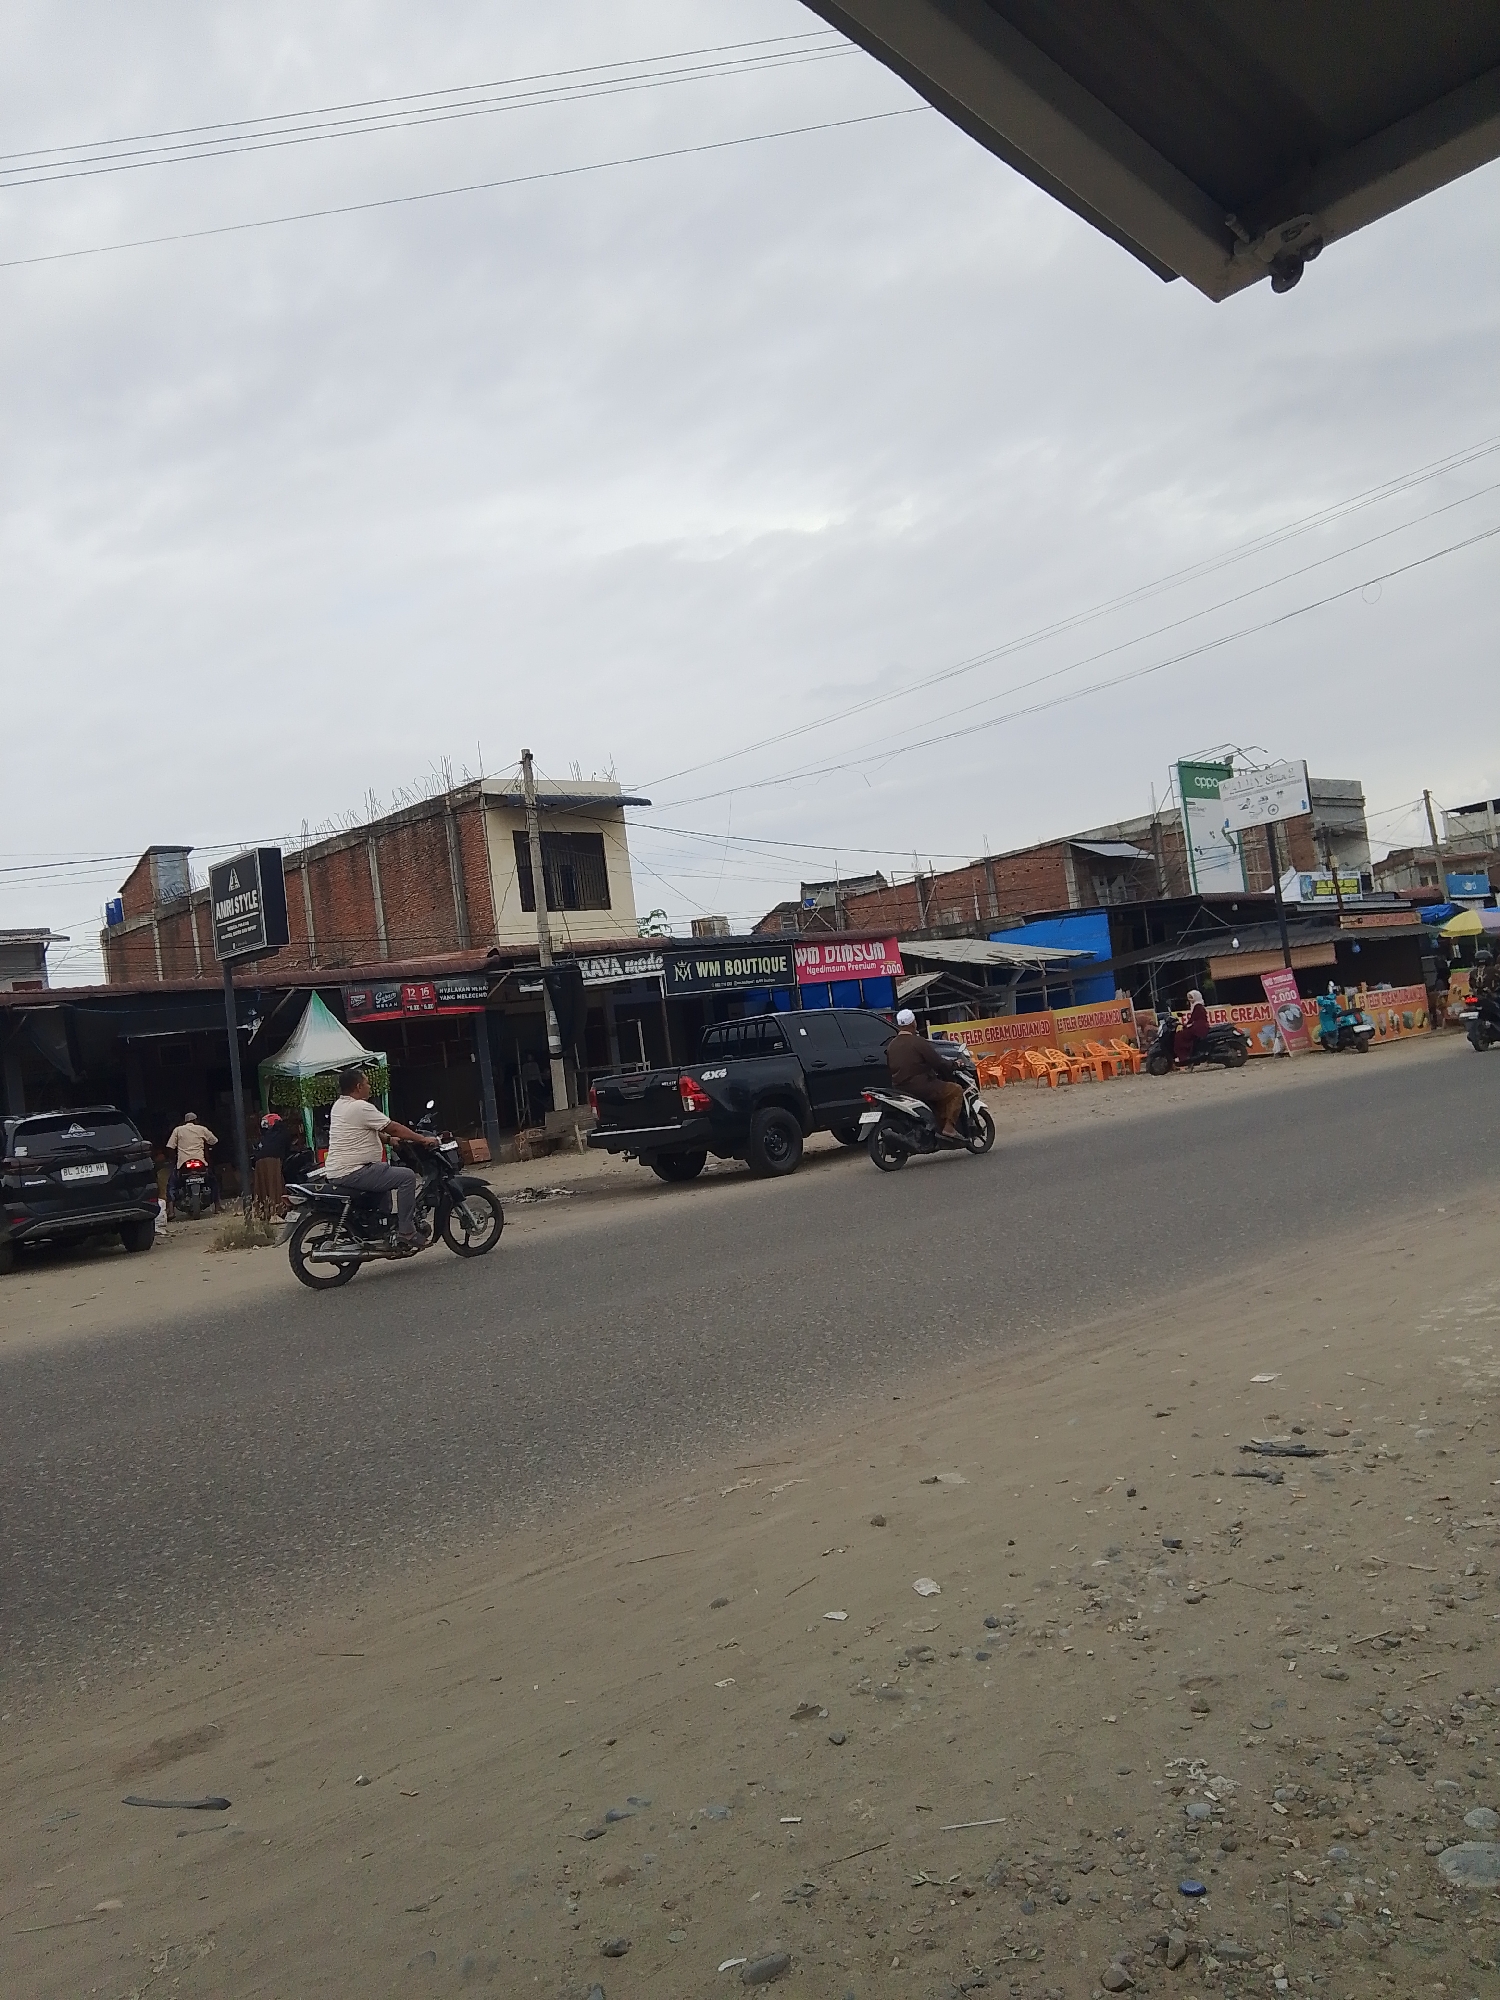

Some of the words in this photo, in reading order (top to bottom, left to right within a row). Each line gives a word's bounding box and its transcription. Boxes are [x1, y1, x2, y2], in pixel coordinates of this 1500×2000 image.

[1195, 776, 1219, 789] oppo
[235, 889, 259, 914] STYLE
[795, 946, 820, 967] WM
[824, 942, 885, 964] DIMSUM
[696, 960, 721, 978] WM
[724, 956, 788, 976] BOUTIQUE
[806, 964, 847, 976] Ngedimsum
[847, 961, 877, 972] Premium
[879, 963, 902, 975] 2.000
[406, 987, 416, 998] 12
[1272, 990, 1297, 1003] 2.000
[1230, 1005, 1271, 1022] CREAM
[961, 1029, 984, 1045] TELER
[984, 1024, 1012, 1042] CREAM
[1011, 1020, 1041, 1040] DURIAN
[1041, 1019, 1051, 1036] 3D
